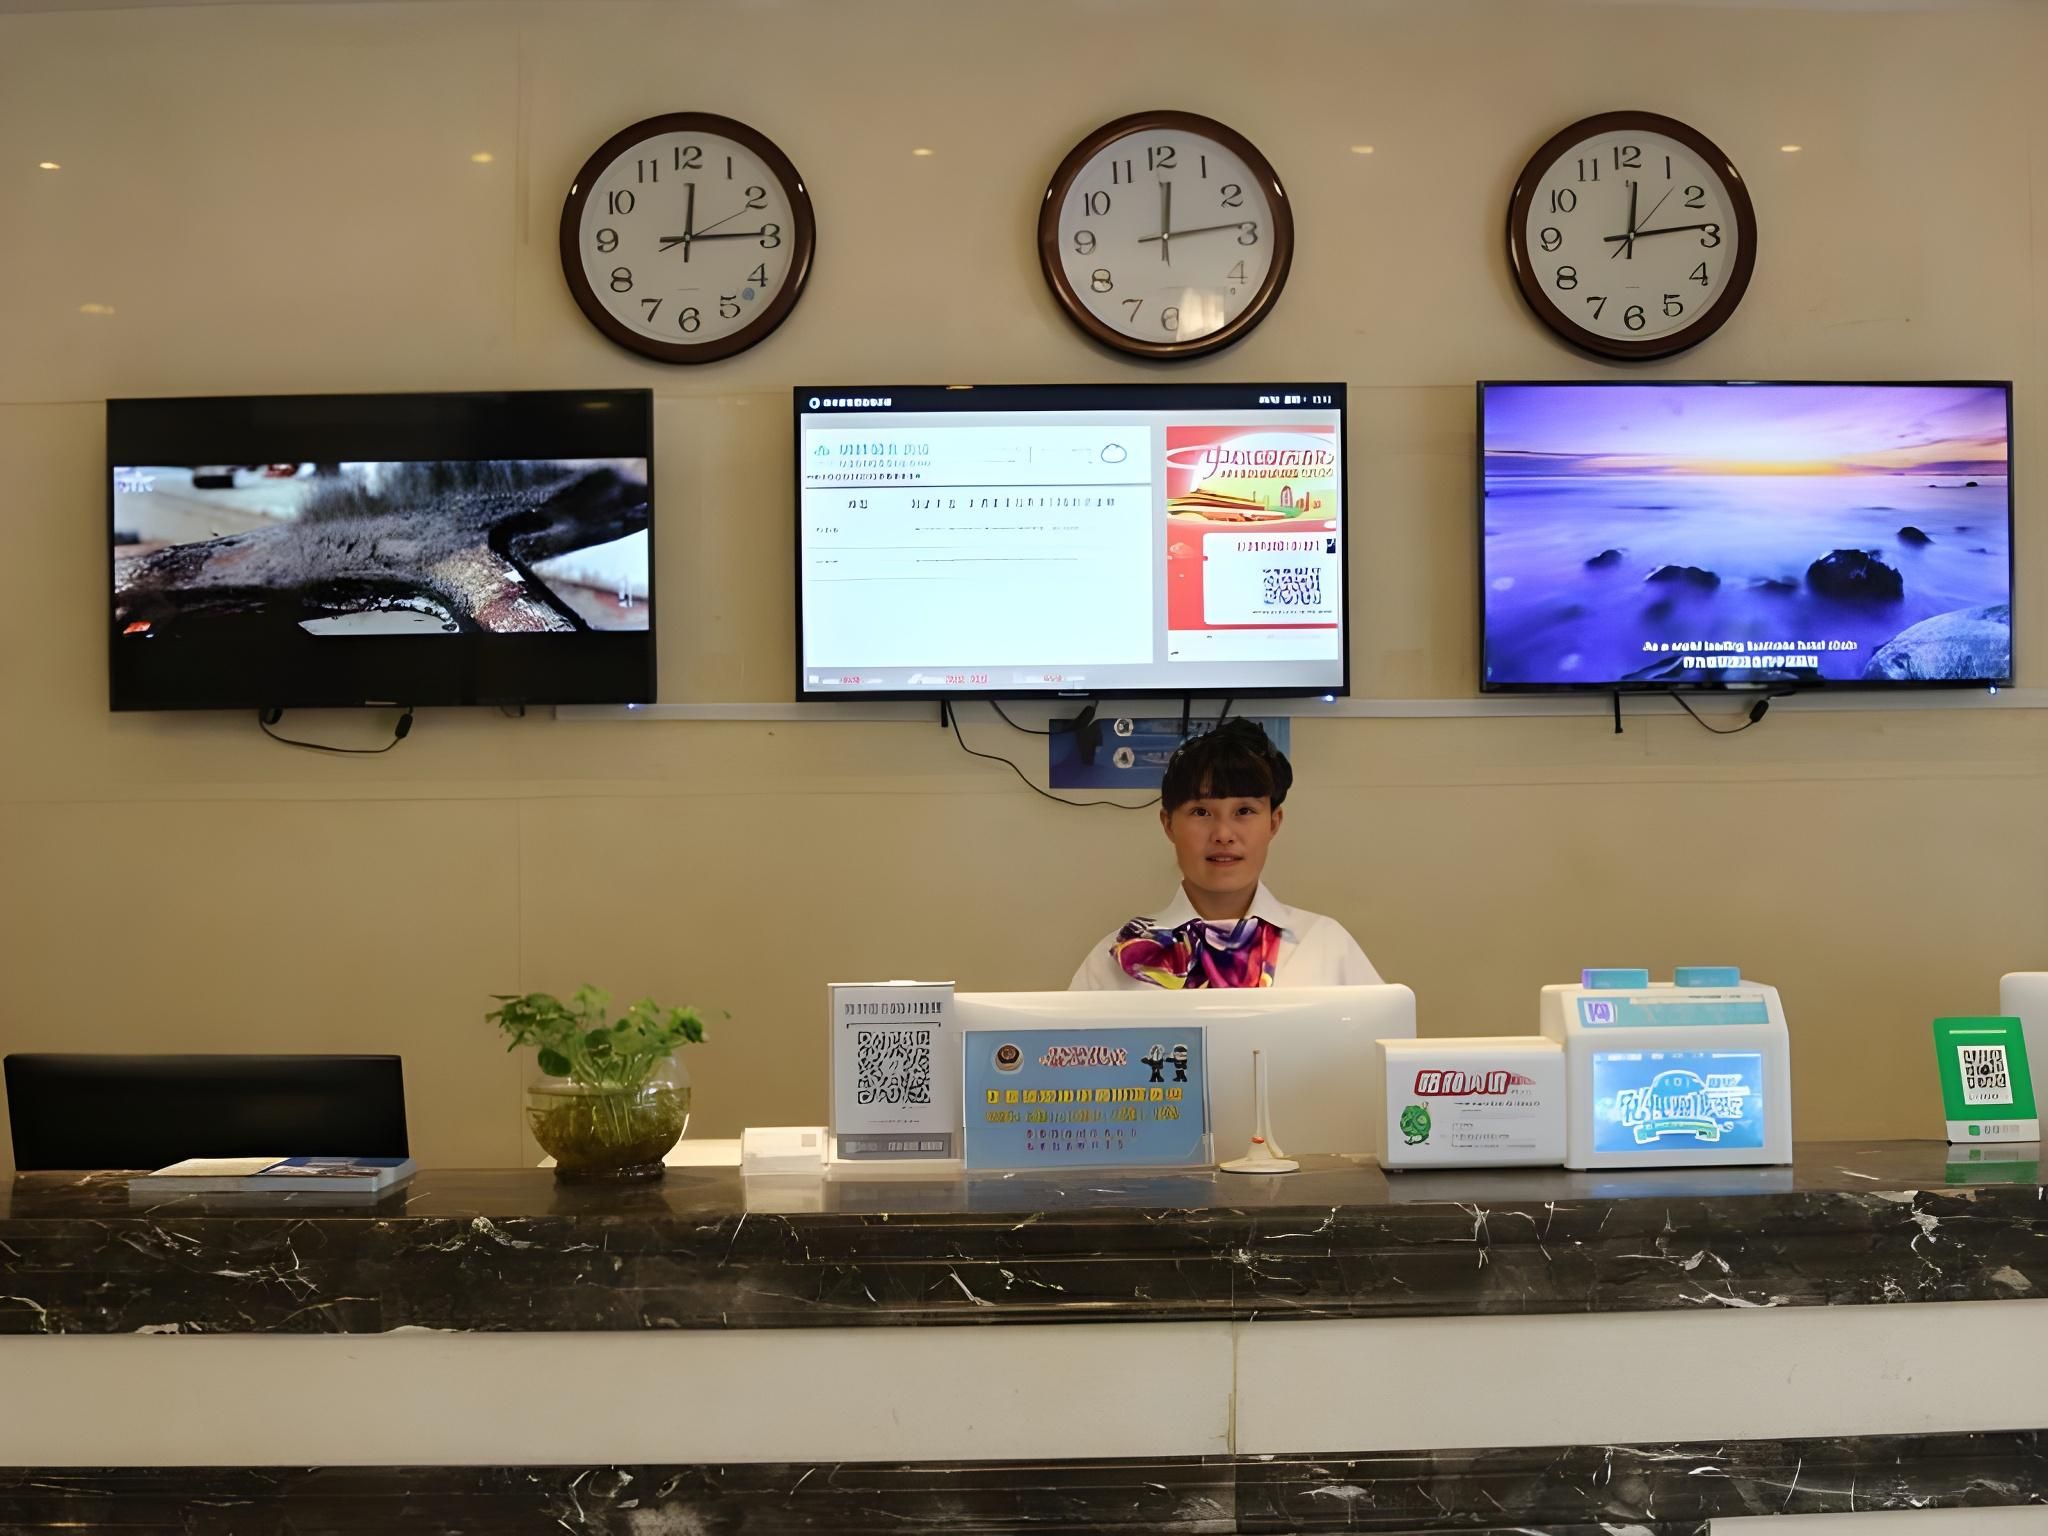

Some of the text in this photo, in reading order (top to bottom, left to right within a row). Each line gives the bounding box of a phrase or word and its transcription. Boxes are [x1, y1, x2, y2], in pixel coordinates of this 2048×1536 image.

[675, 146, 702, 170] 12
[727, 157, 732, 179] 1
[1148, 146, 1176, 171] 12
[1201, 156, 1206, 178] 1
[1578, 158, 1600, 181] 11
[1614, 146, 1641, 170] 12
[1666, 156, 1670, 179] 1
[638, 160, 657, 183] 11
[1113, 160, 1131, 184] 11
[609, 190, 635, 214] 10
[745, 186, 767, 209] 2
[1085, 191, 1110, 216] 10
[1221, 184, 1243, 207] 2
[1552, 189, 1576, 213] 10
[1684, 186, 1705, 209] 2
[596, 228, 618, 253] 9
[759, 223, 782, 249] 3
[1074, 231, 1096, 254] 9
[1237, 222, 1259, 246] 3
[1541, 227, 1562, 252] 9
[1699, 223, 1721, 249] 3
[610, 267, 633, 293] 8
[747, 263, 768, 287] 4
[1091, 269, 1113, 293] 8
[1227, 260, 1248, 285] 4
[1556, 266, 1577, 290] 8
[1689, 262, 1708, 286] 4
[641, 299, 662, 322] 7
[720, 296, 740, 318] 5
[1122, 299, 1143, 322] 7
[1587, 297, 1607, 320] 7
[1624, 305, 1645, 330] 6
[1663, 294, 1683, 317] 5
[679, 308, 700, 332] 6
